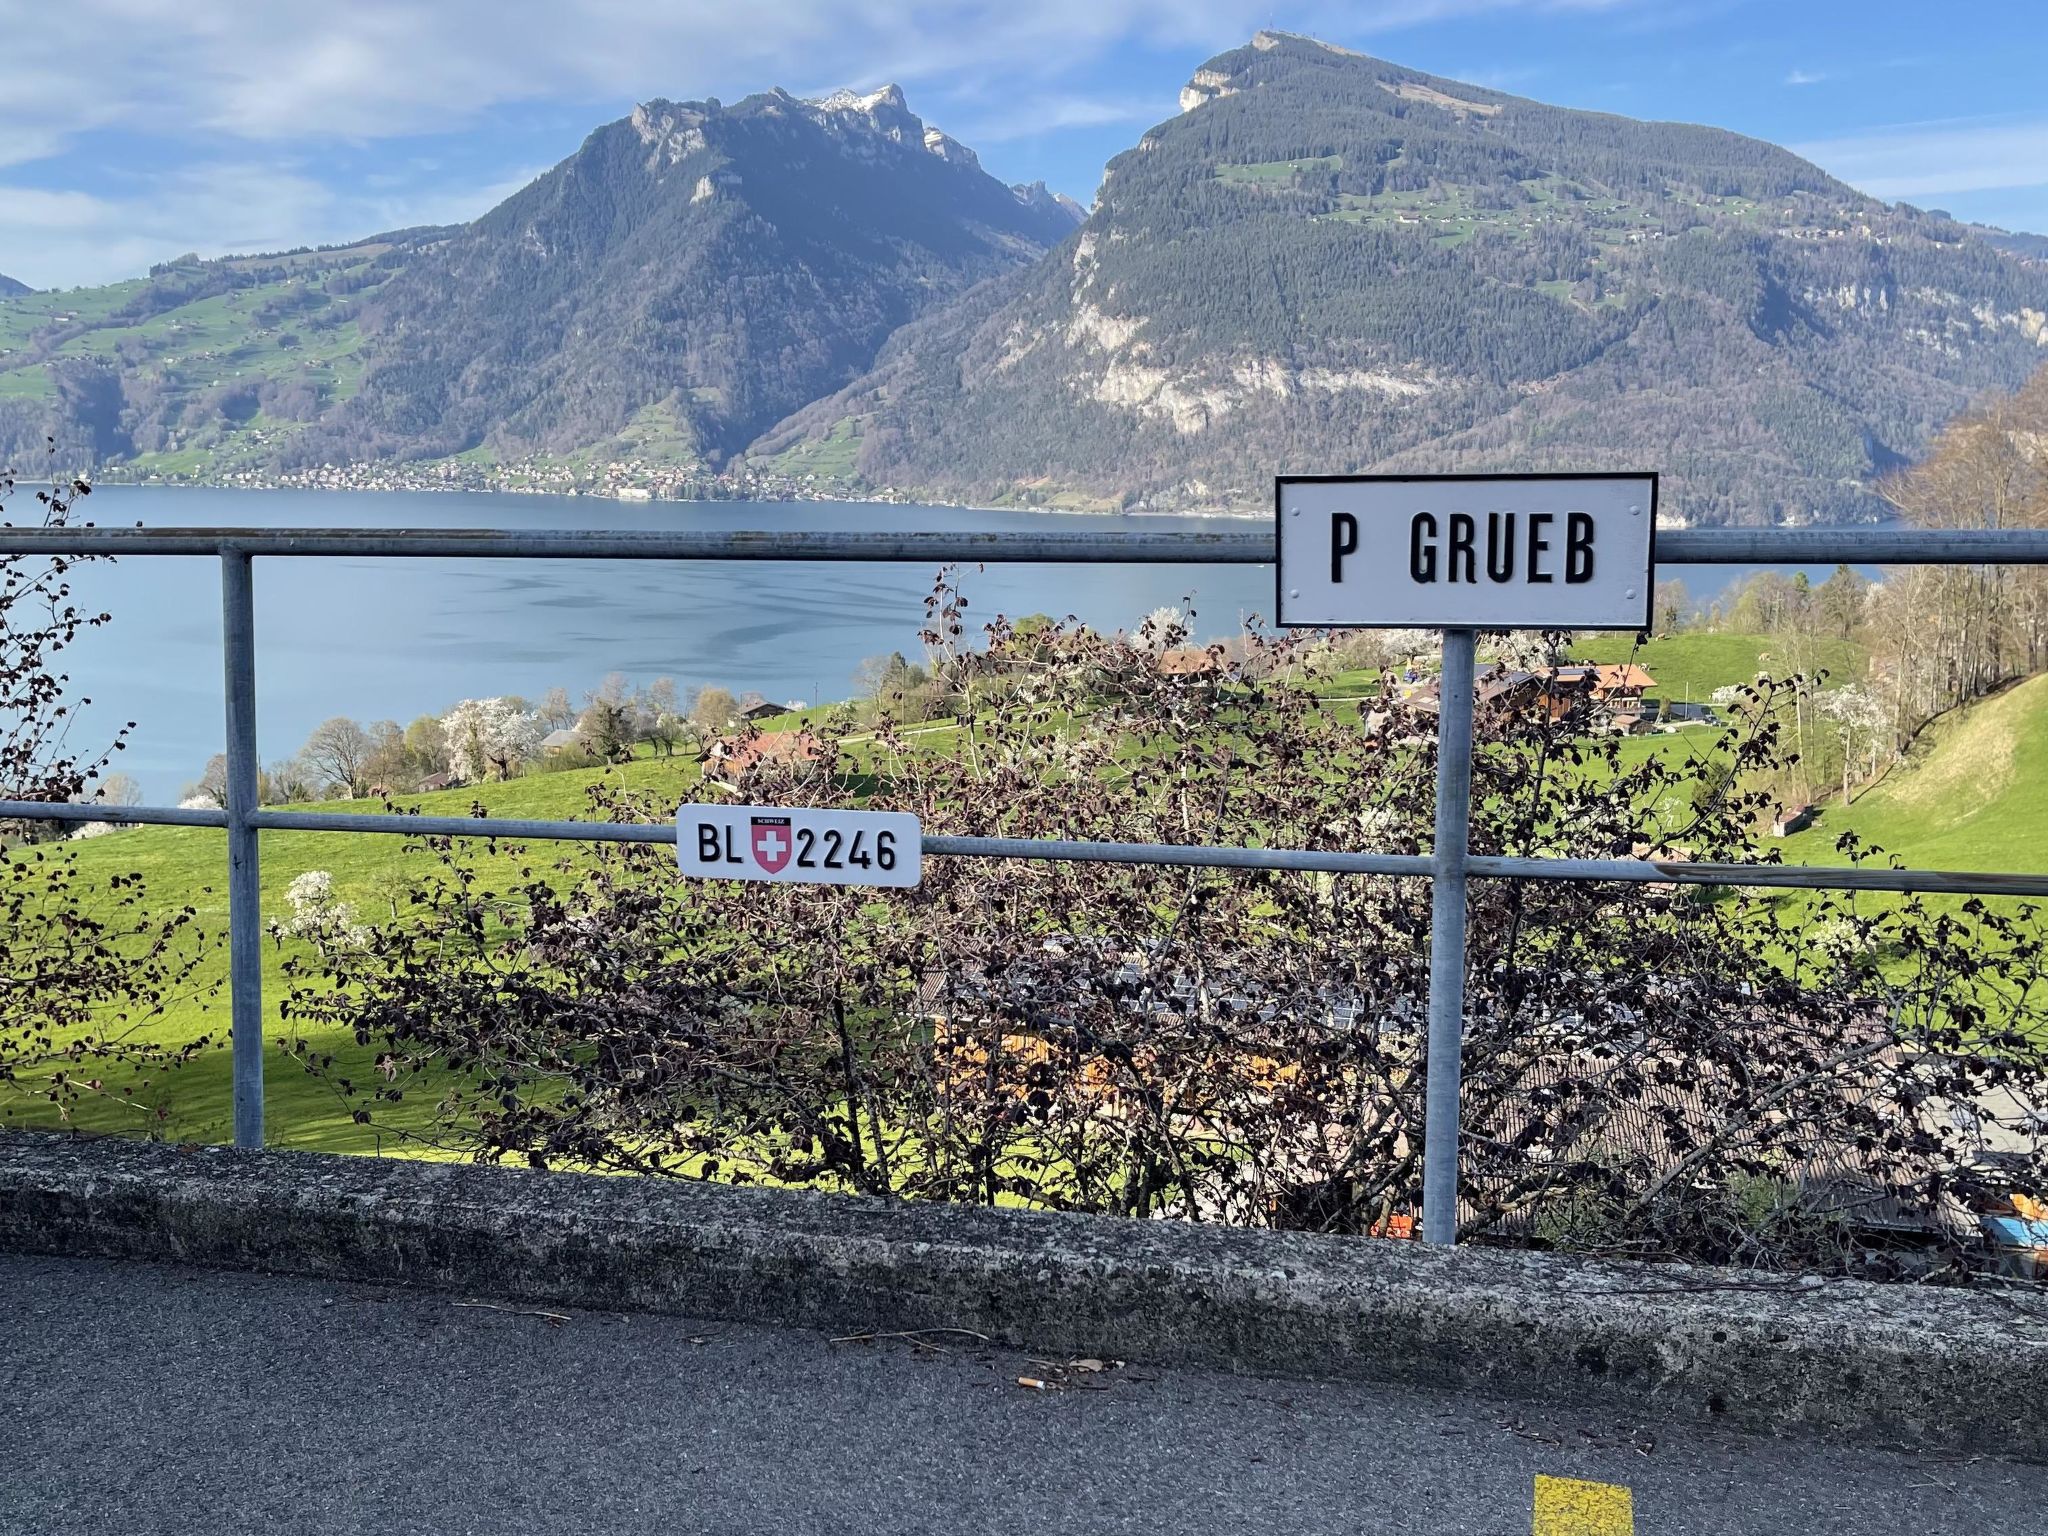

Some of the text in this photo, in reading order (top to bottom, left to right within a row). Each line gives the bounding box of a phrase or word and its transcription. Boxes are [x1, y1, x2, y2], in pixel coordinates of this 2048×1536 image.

[1331, 511, 1594, 584] P GRUEB
[698, 823, 896, 870] BL 2246
